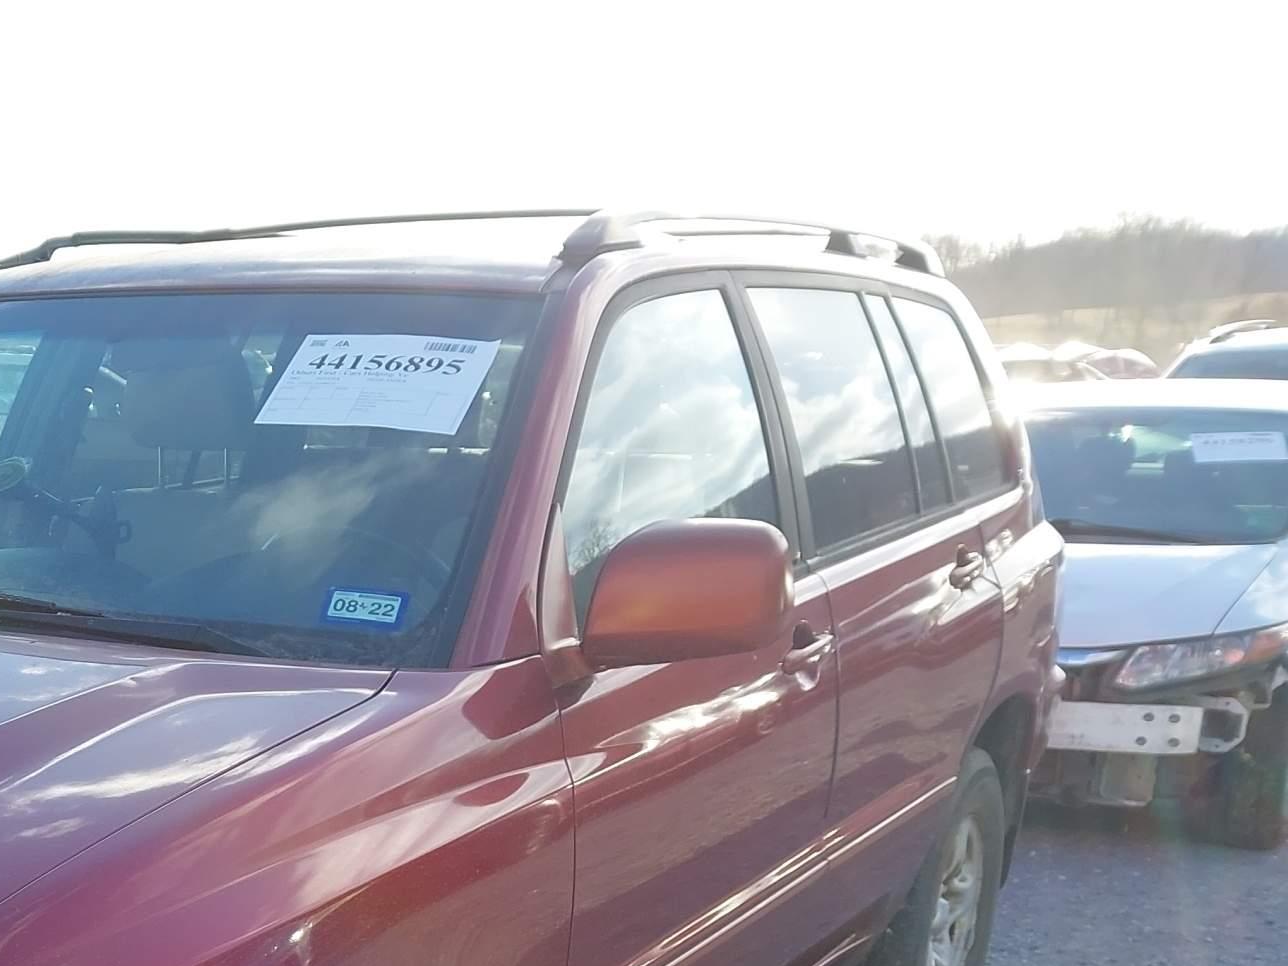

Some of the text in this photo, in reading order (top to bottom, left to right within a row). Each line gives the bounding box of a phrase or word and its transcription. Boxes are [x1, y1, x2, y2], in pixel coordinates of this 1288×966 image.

[308, 353, 466, 376] 44156895
[333, 598, 395, 618] 08 22
